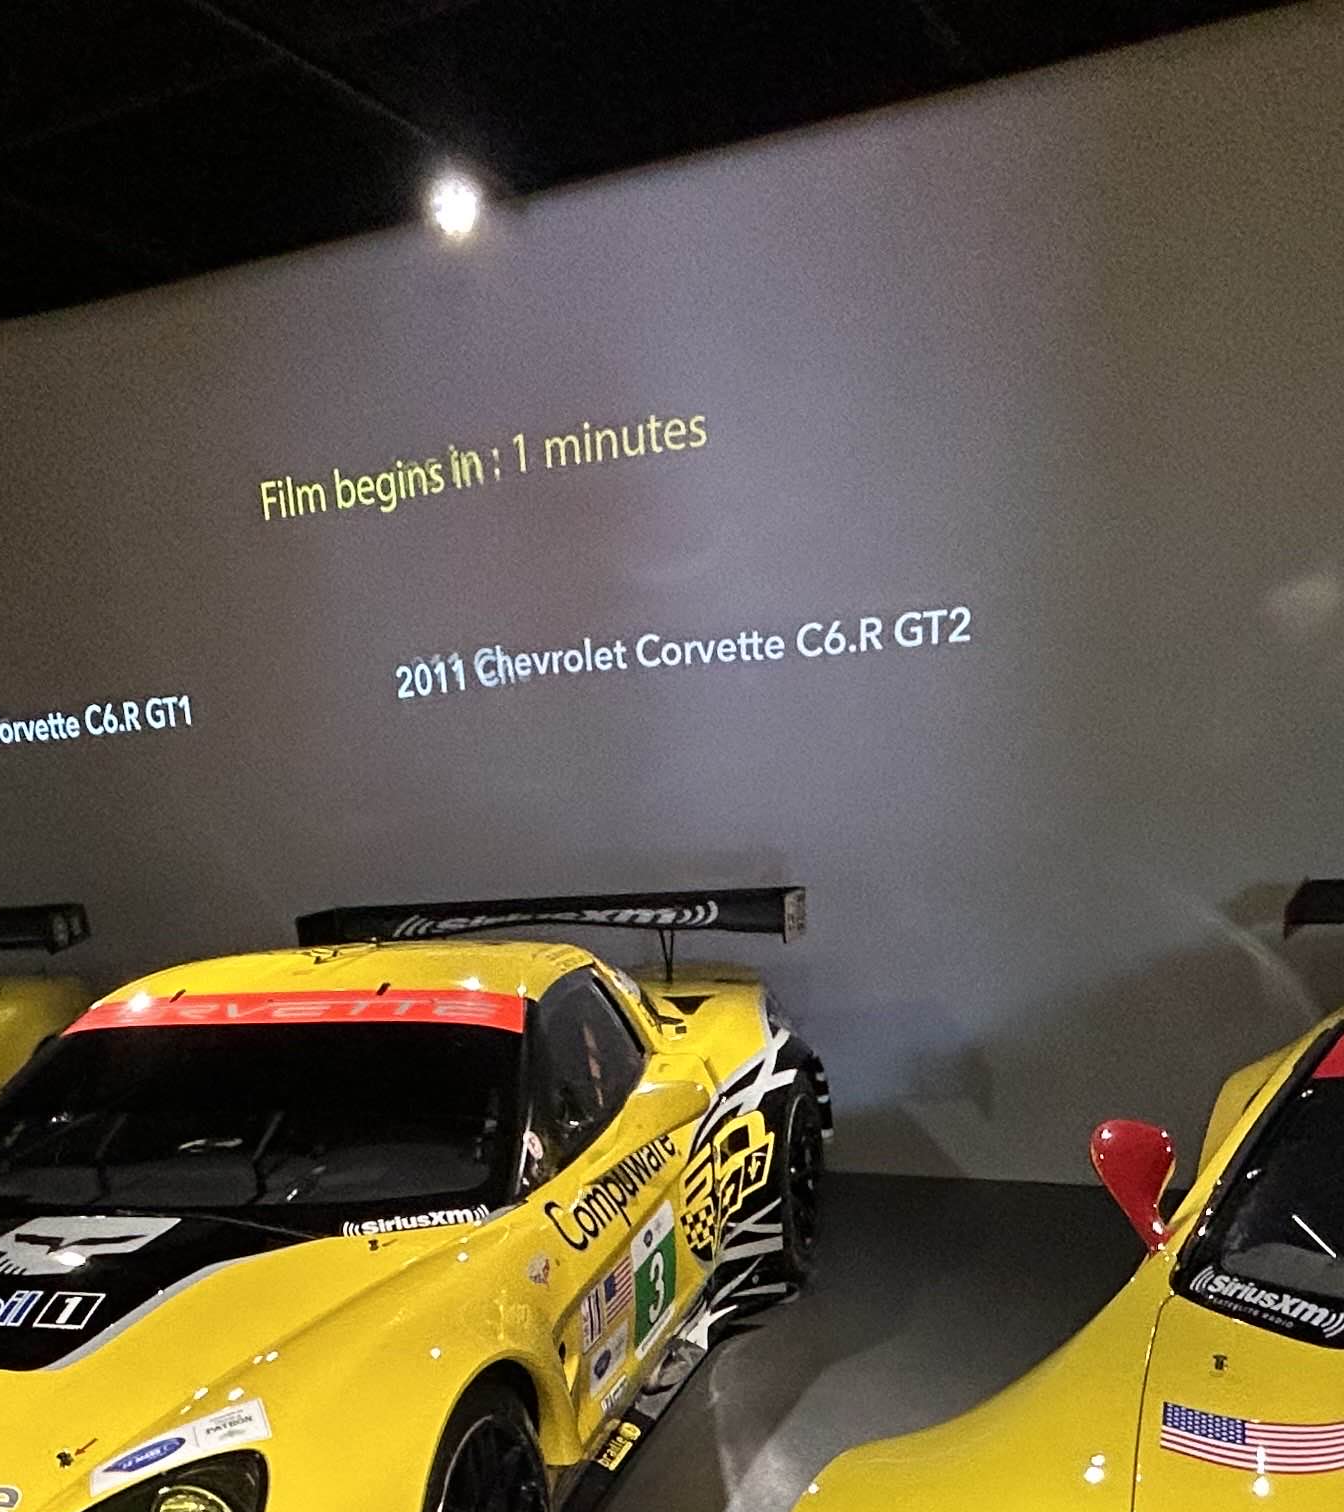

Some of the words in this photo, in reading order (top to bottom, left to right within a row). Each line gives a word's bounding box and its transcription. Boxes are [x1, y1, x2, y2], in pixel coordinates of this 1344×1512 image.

[258, 477, 327, 521] Film
[333, 459, 444, 513] begins
[448, 445, 485, 489] in
[512, 432, 529, 473] 1
[544, 413, 709, 469] minutes
[395, 656, 467, 699] 2011
[473, 637, 628, 688] Chevrolet
[635, 629, 785, 669] Corvette
[795, 616, 884, 659] C6.R
[893, 606, 972, 649] GT2
[84, 699, 142, 736] C6.R
[145, 694, 194, 729] GT1
[543, 1134, 676, 1251] Compuware
[648, 1250, 666, 1325] 3
